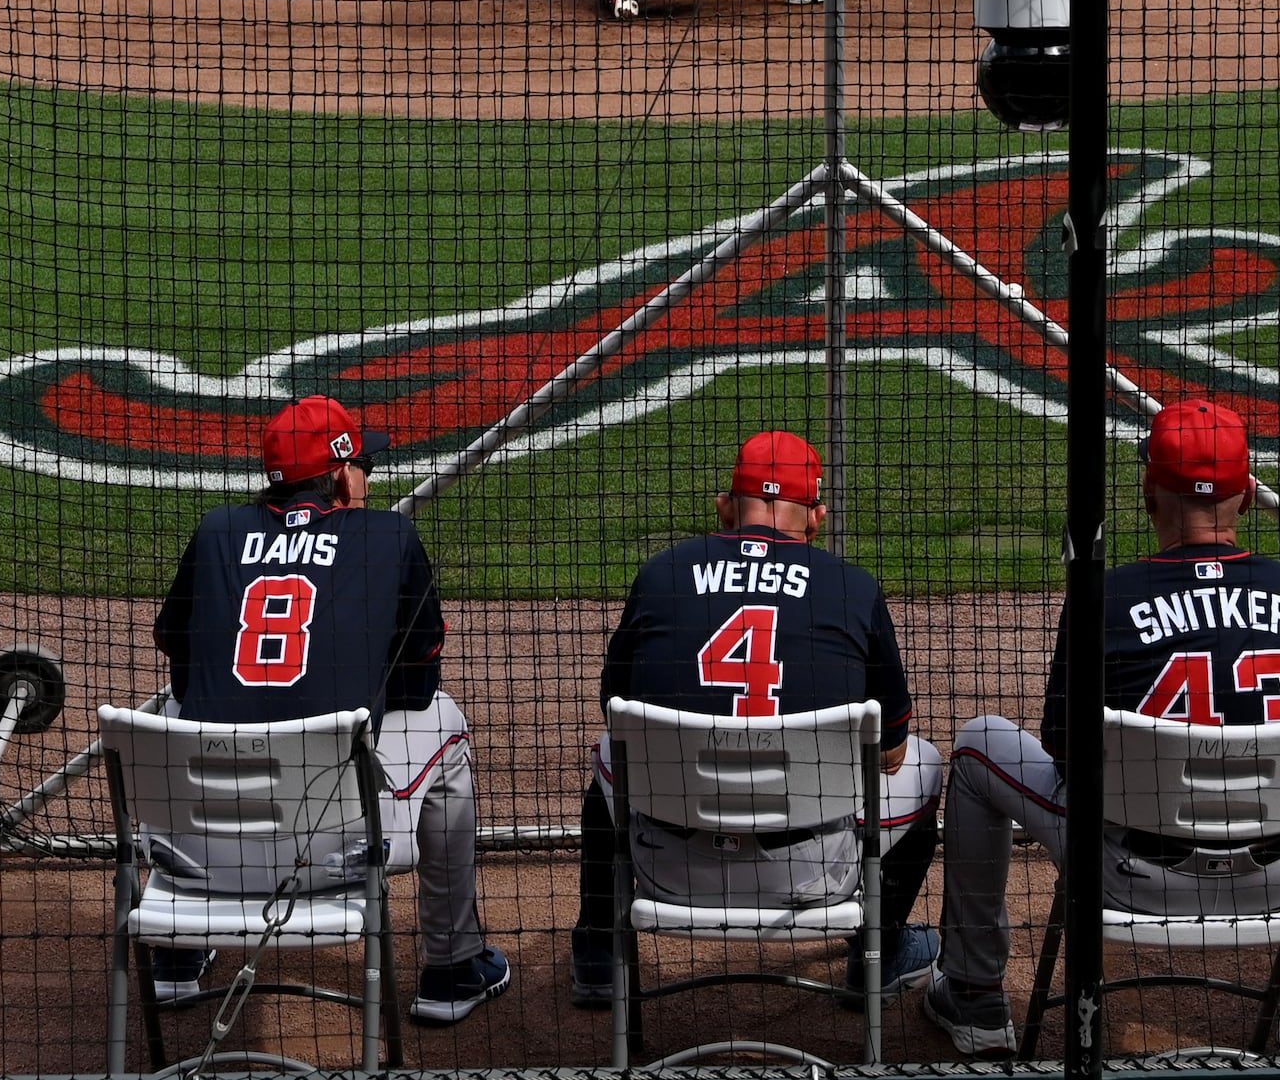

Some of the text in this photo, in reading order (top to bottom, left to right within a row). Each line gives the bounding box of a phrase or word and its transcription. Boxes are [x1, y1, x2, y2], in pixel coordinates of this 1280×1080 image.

[240, 530, 339, 567] DAVIS
[692, 560, 811, 599] WEISS
[232, 573, 317, 687] 8
[696, 605, 784, 718] 4
